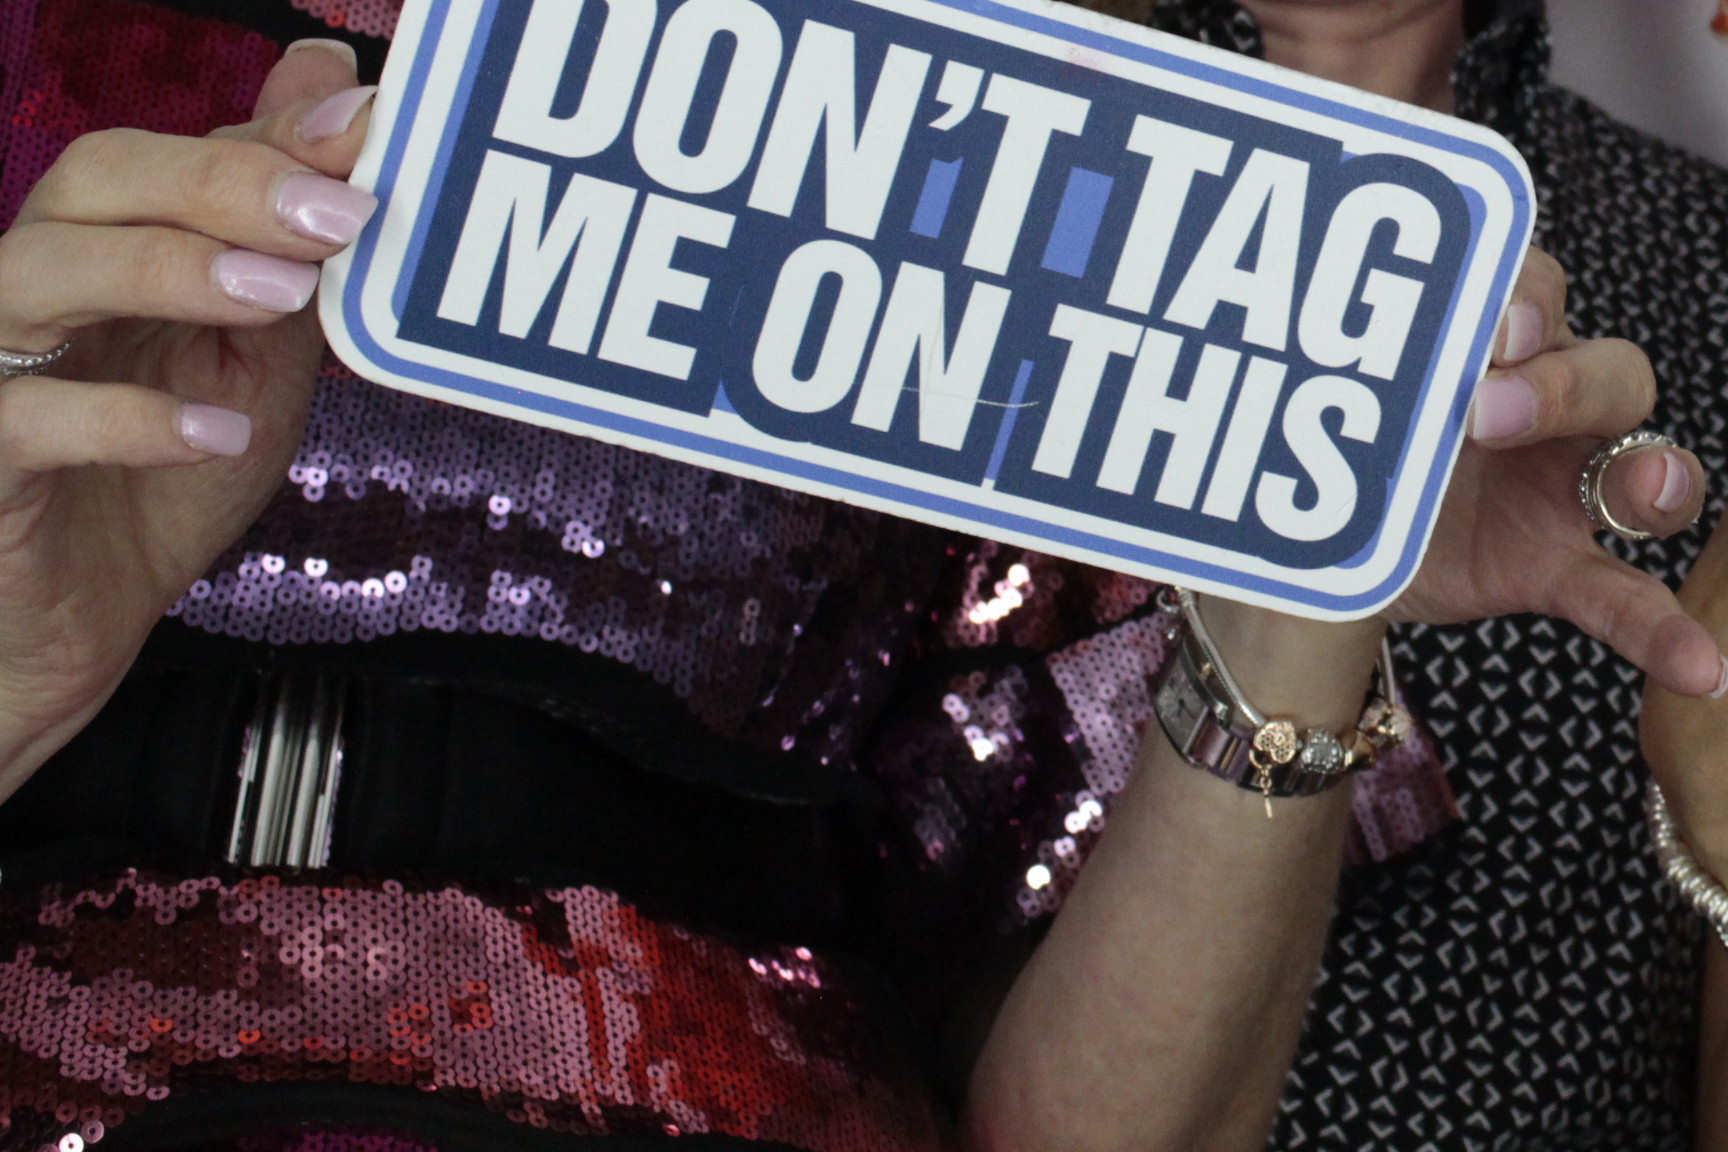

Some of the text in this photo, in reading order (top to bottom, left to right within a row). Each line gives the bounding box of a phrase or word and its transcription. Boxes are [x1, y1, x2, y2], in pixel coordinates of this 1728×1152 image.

[435, 148, 1383, 543] ME ON THIS
[1106, 112, 1443, 382] TAG
